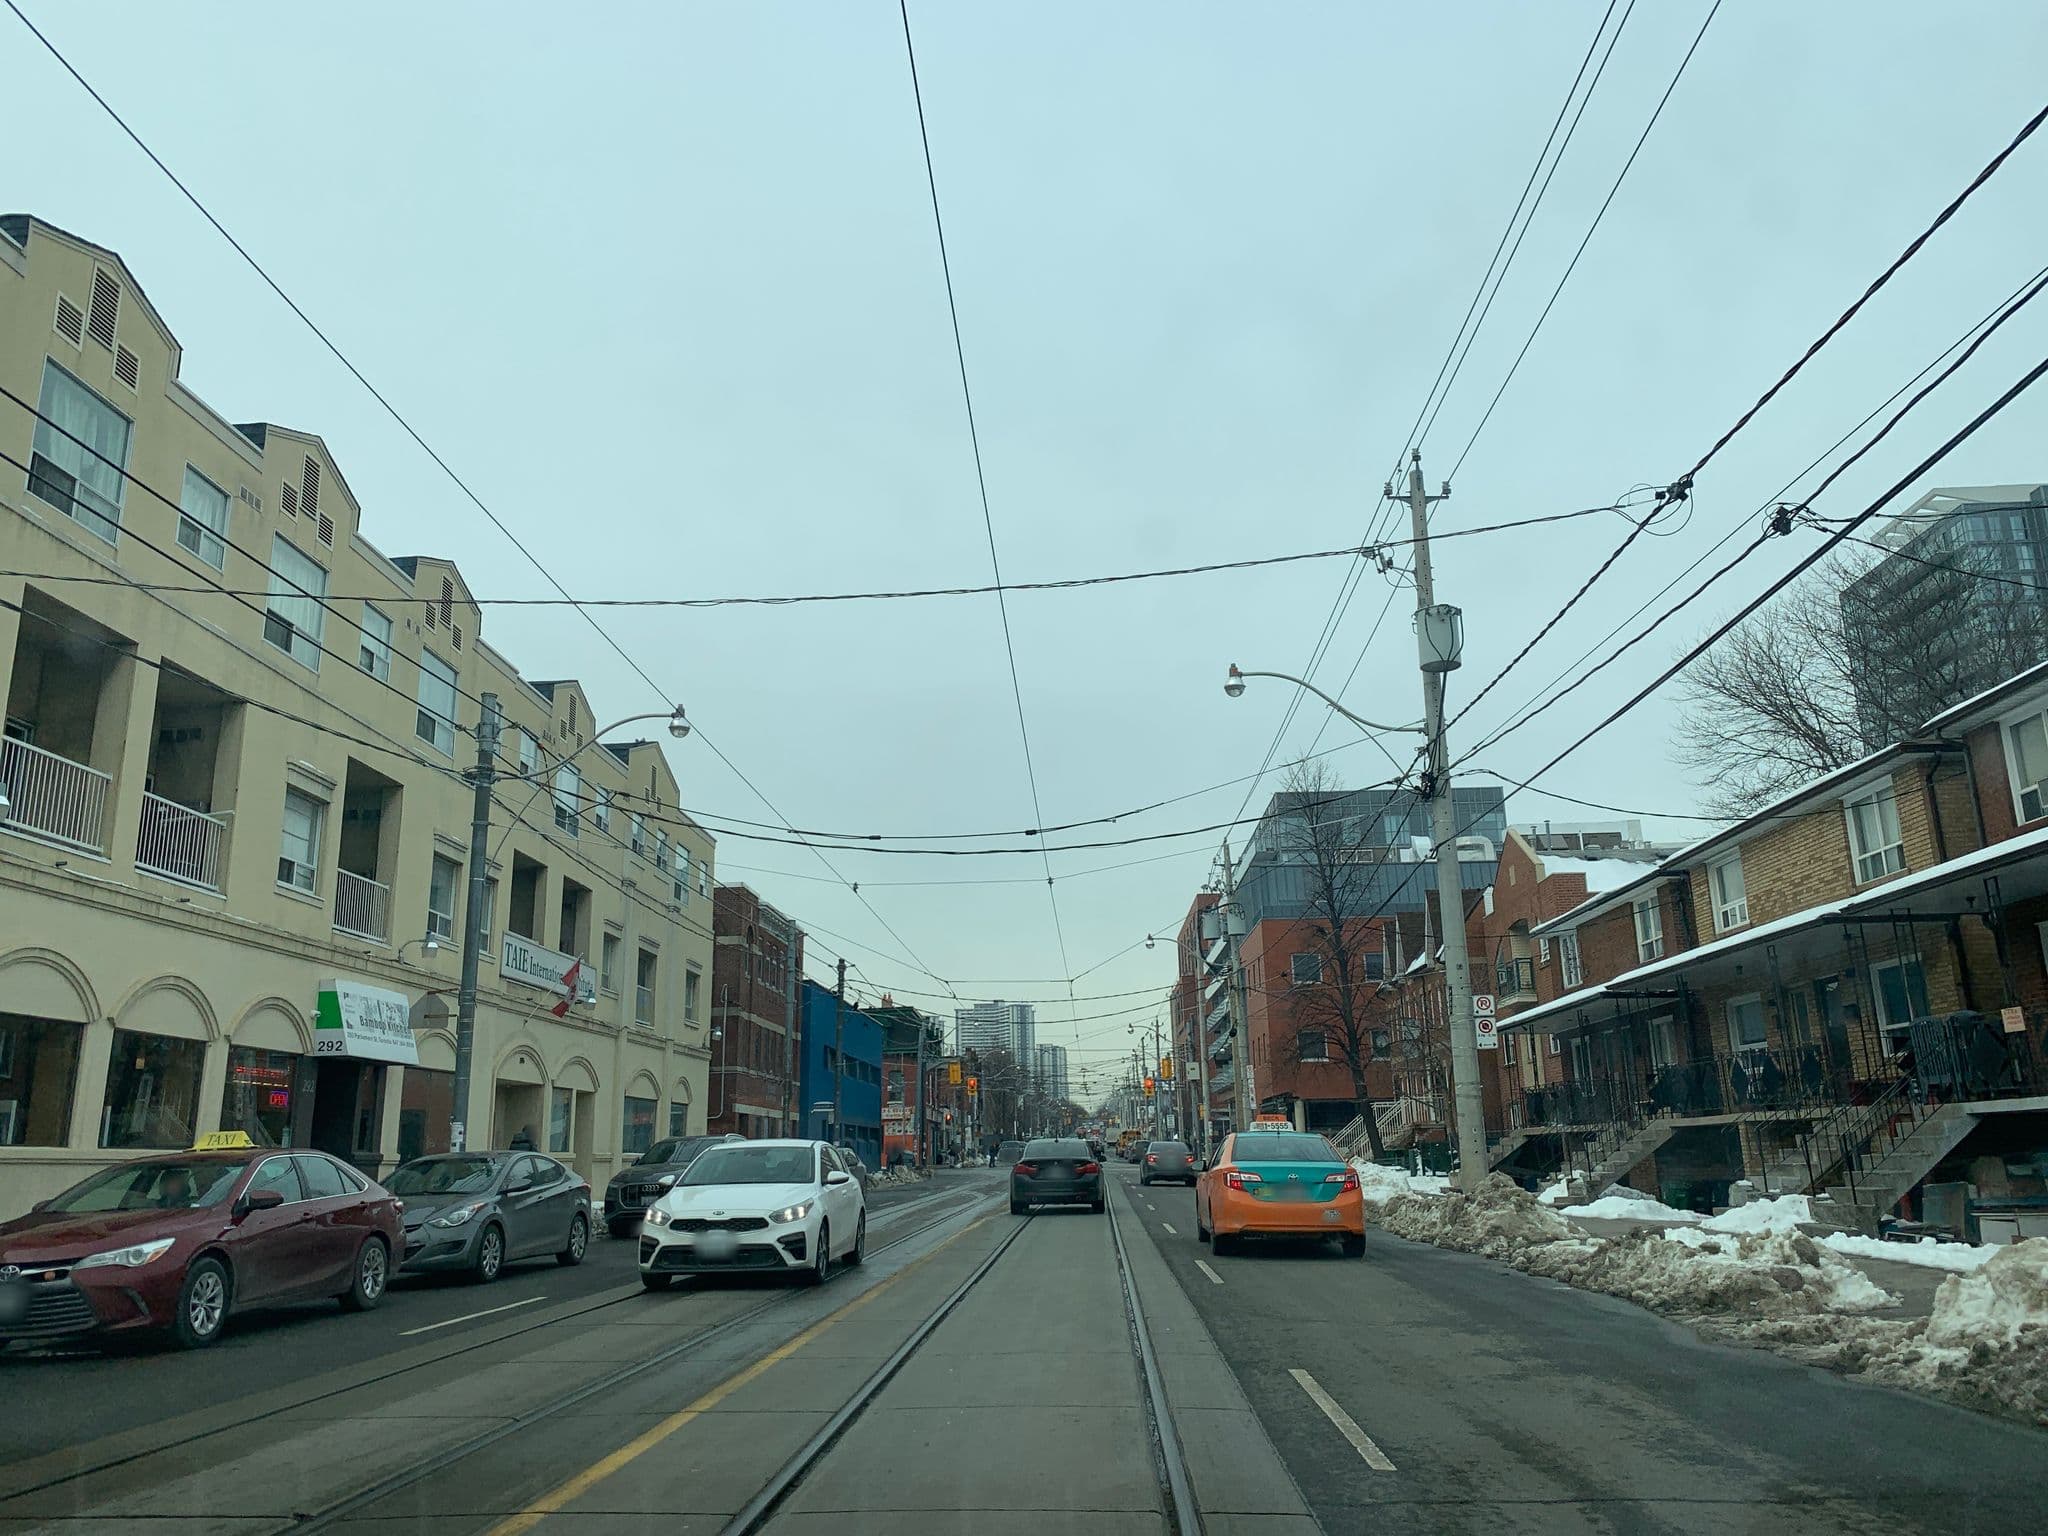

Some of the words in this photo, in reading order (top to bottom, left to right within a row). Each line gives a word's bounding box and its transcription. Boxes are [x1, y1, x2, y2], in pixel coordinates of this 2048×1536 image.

[529, 956, 564, 985] Internation
[359, 1015, 387, 1031] Bamboo
[318, 1041, 343, 1052] 292
[1253, 1122, 1289, 1130] 1-5555
[207, 1133, 237, 1146] TAXI
